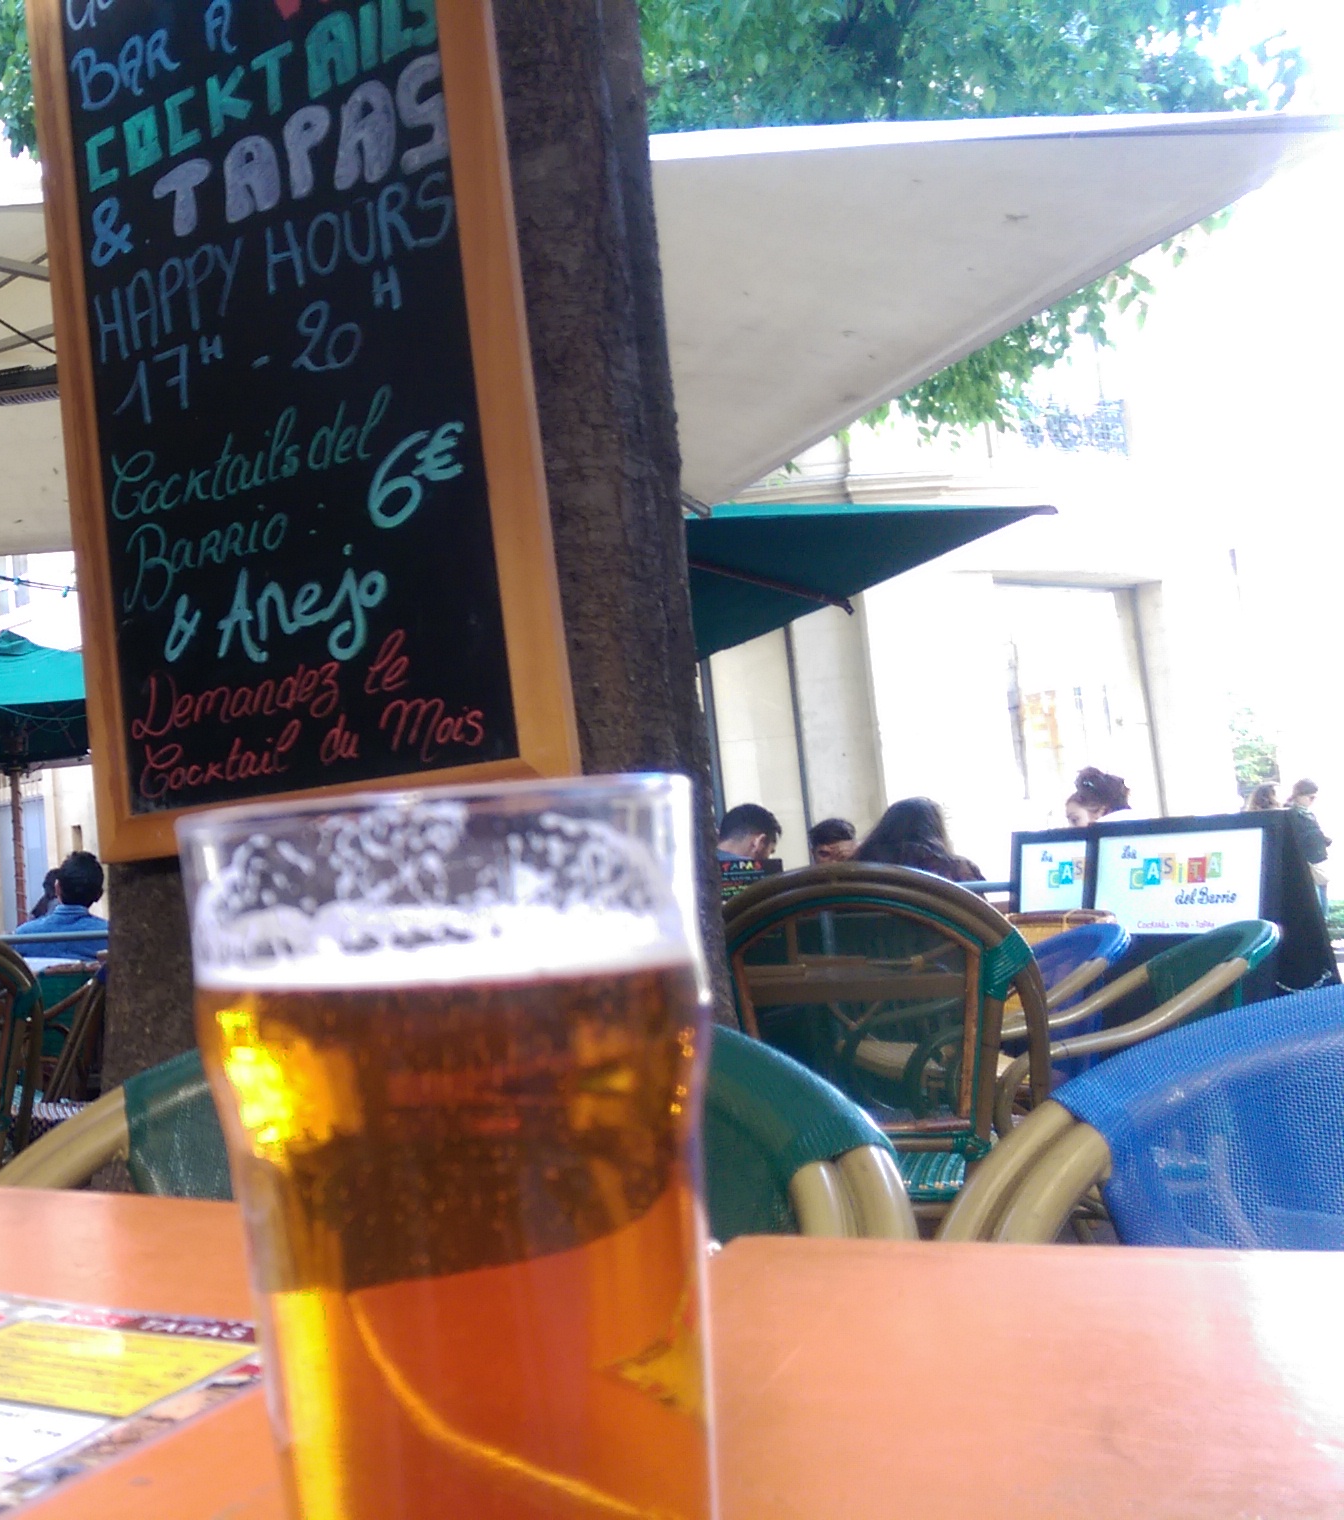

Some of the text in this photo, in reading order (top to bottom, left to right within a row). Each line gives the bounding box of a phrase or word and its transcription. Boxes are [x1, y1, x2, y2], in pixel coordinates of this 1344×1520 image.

[69, 28, 182, 112] BAR
[84, 0, 440, 192] COCKTAILS
[90, 52, 452, 269] & TAPAS
[93, 171, 455, 365] HAPPY HOURS
[111, 382, 393, 521] Cocktails del
[367, 420, 465, 529] 6€
[130, 628, 411, 742] Demandez le
[140, 698, 486, 799] Cocktail du Mois
[139, 1318, 248, 1340] TAPAS
